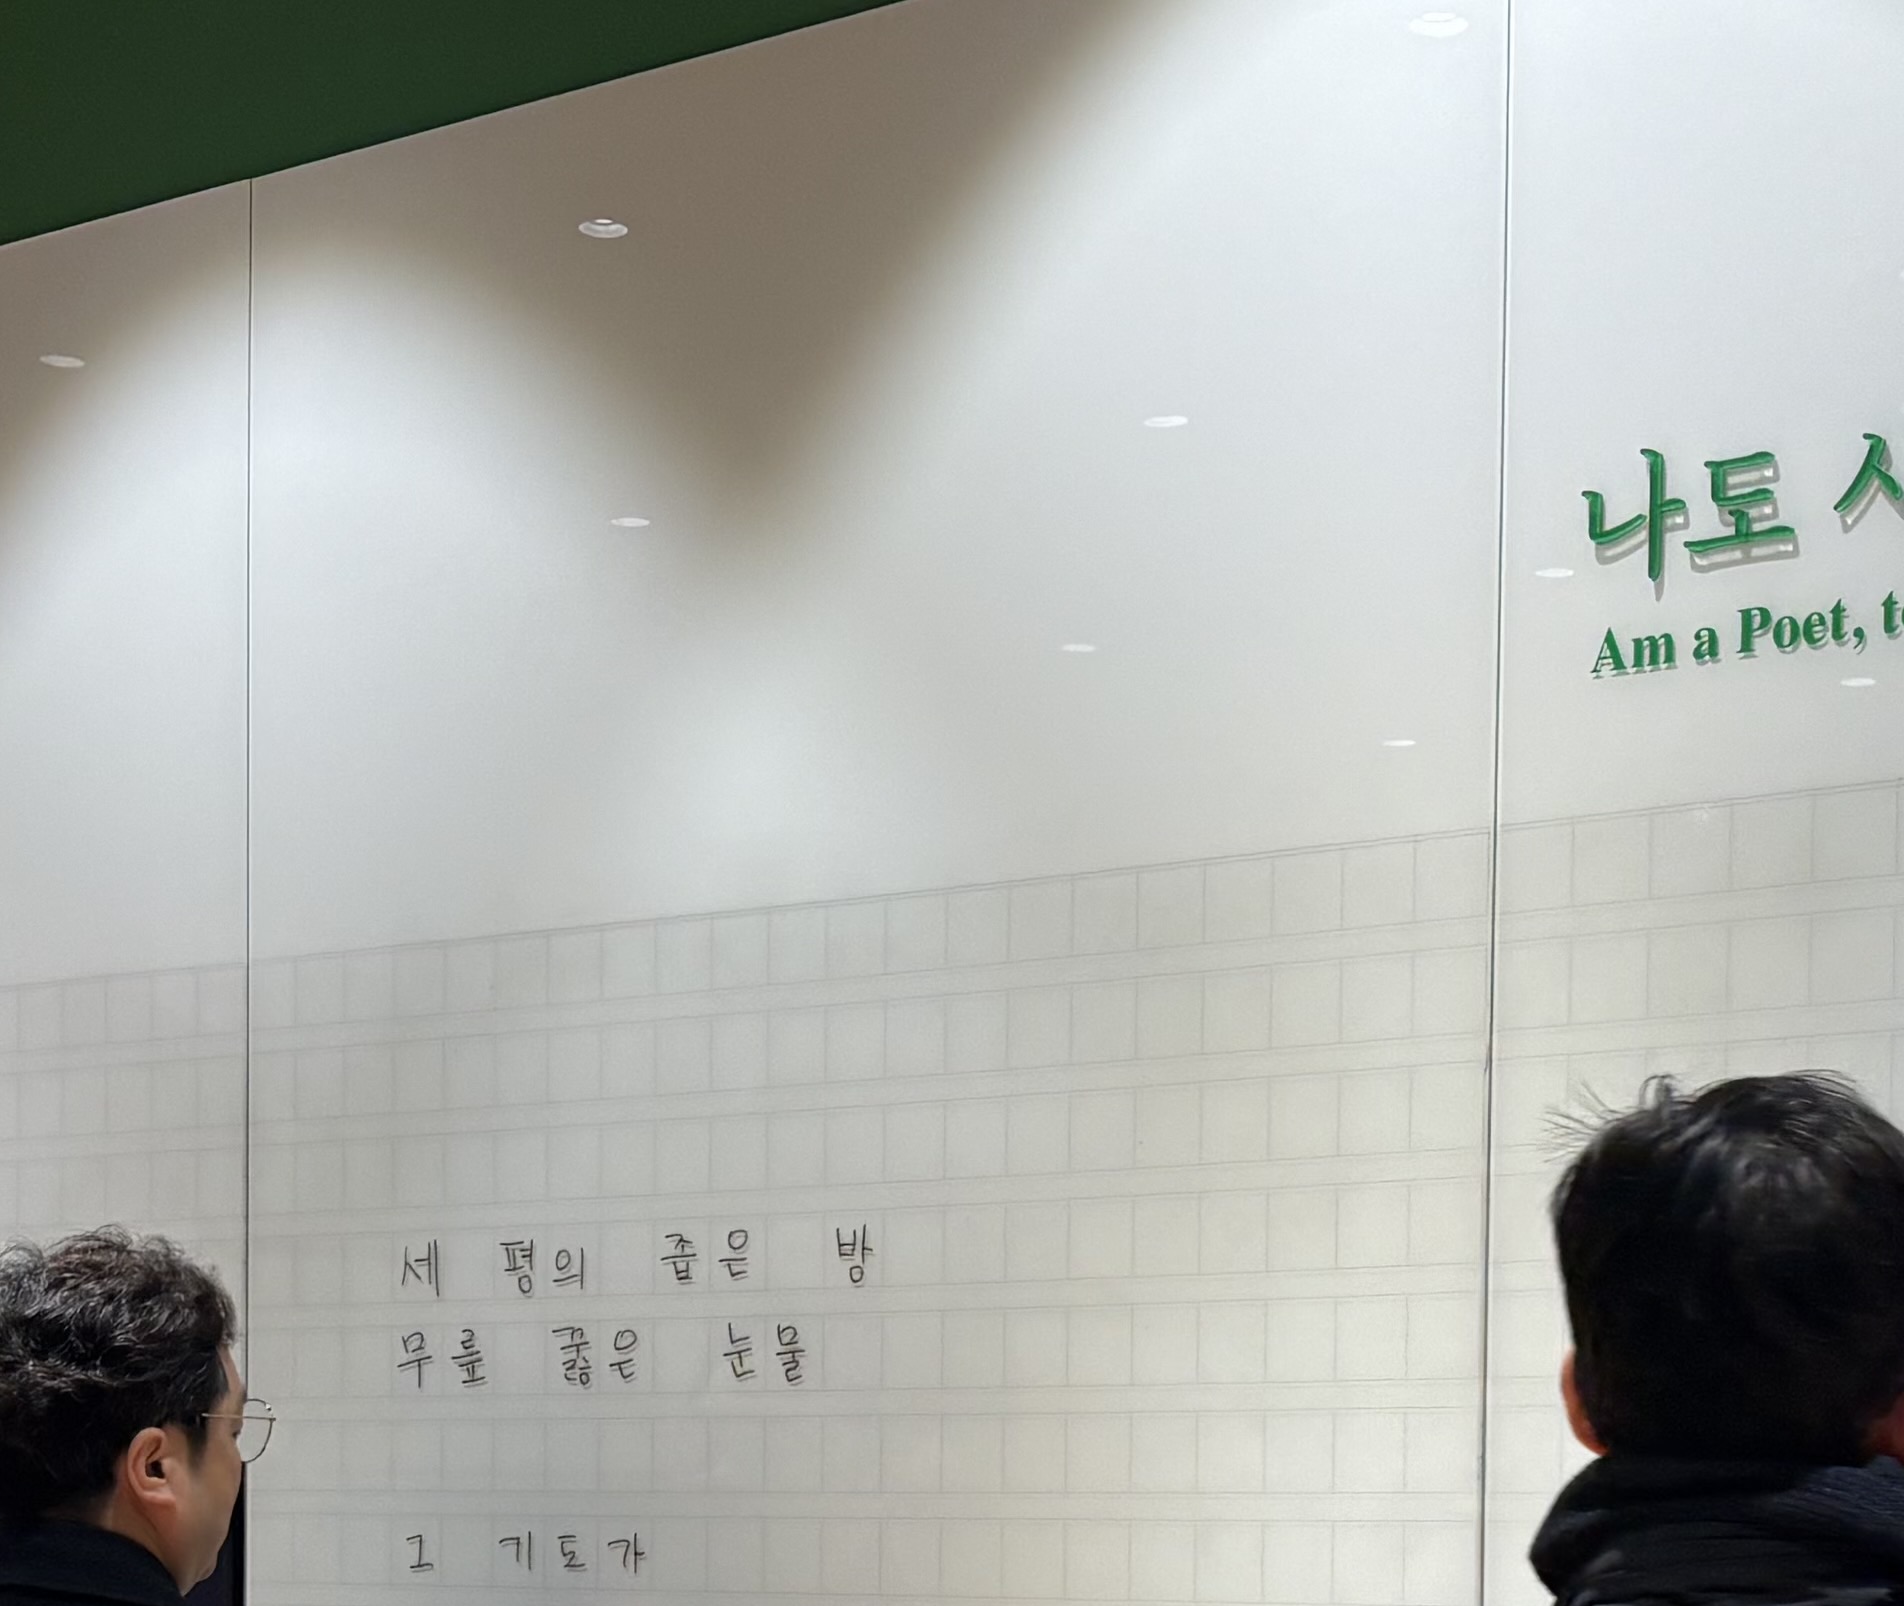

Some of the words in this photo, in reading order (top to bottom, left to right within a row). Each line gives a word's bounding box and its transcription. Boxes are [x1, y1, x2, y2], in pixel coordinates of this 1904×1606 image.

[1581, 448, 1799, 584] 나도
[1590, 627, 1677, 676] Am
[1690, 622, 1721, 663] a
[1737, 597, 1868, 658] Poet,
[400, 1238, 442, 1298] 세
[499, 1238, 586, 1297] 평의
[836, 1223, 874, 1285] 방
[396, 1327, 488, 1390] 무릎
[721, 1321, 807, 1384] 눈물
[406, 1533, 435, 1572] 그
[497, 1530, 647, 1576] 기도가
